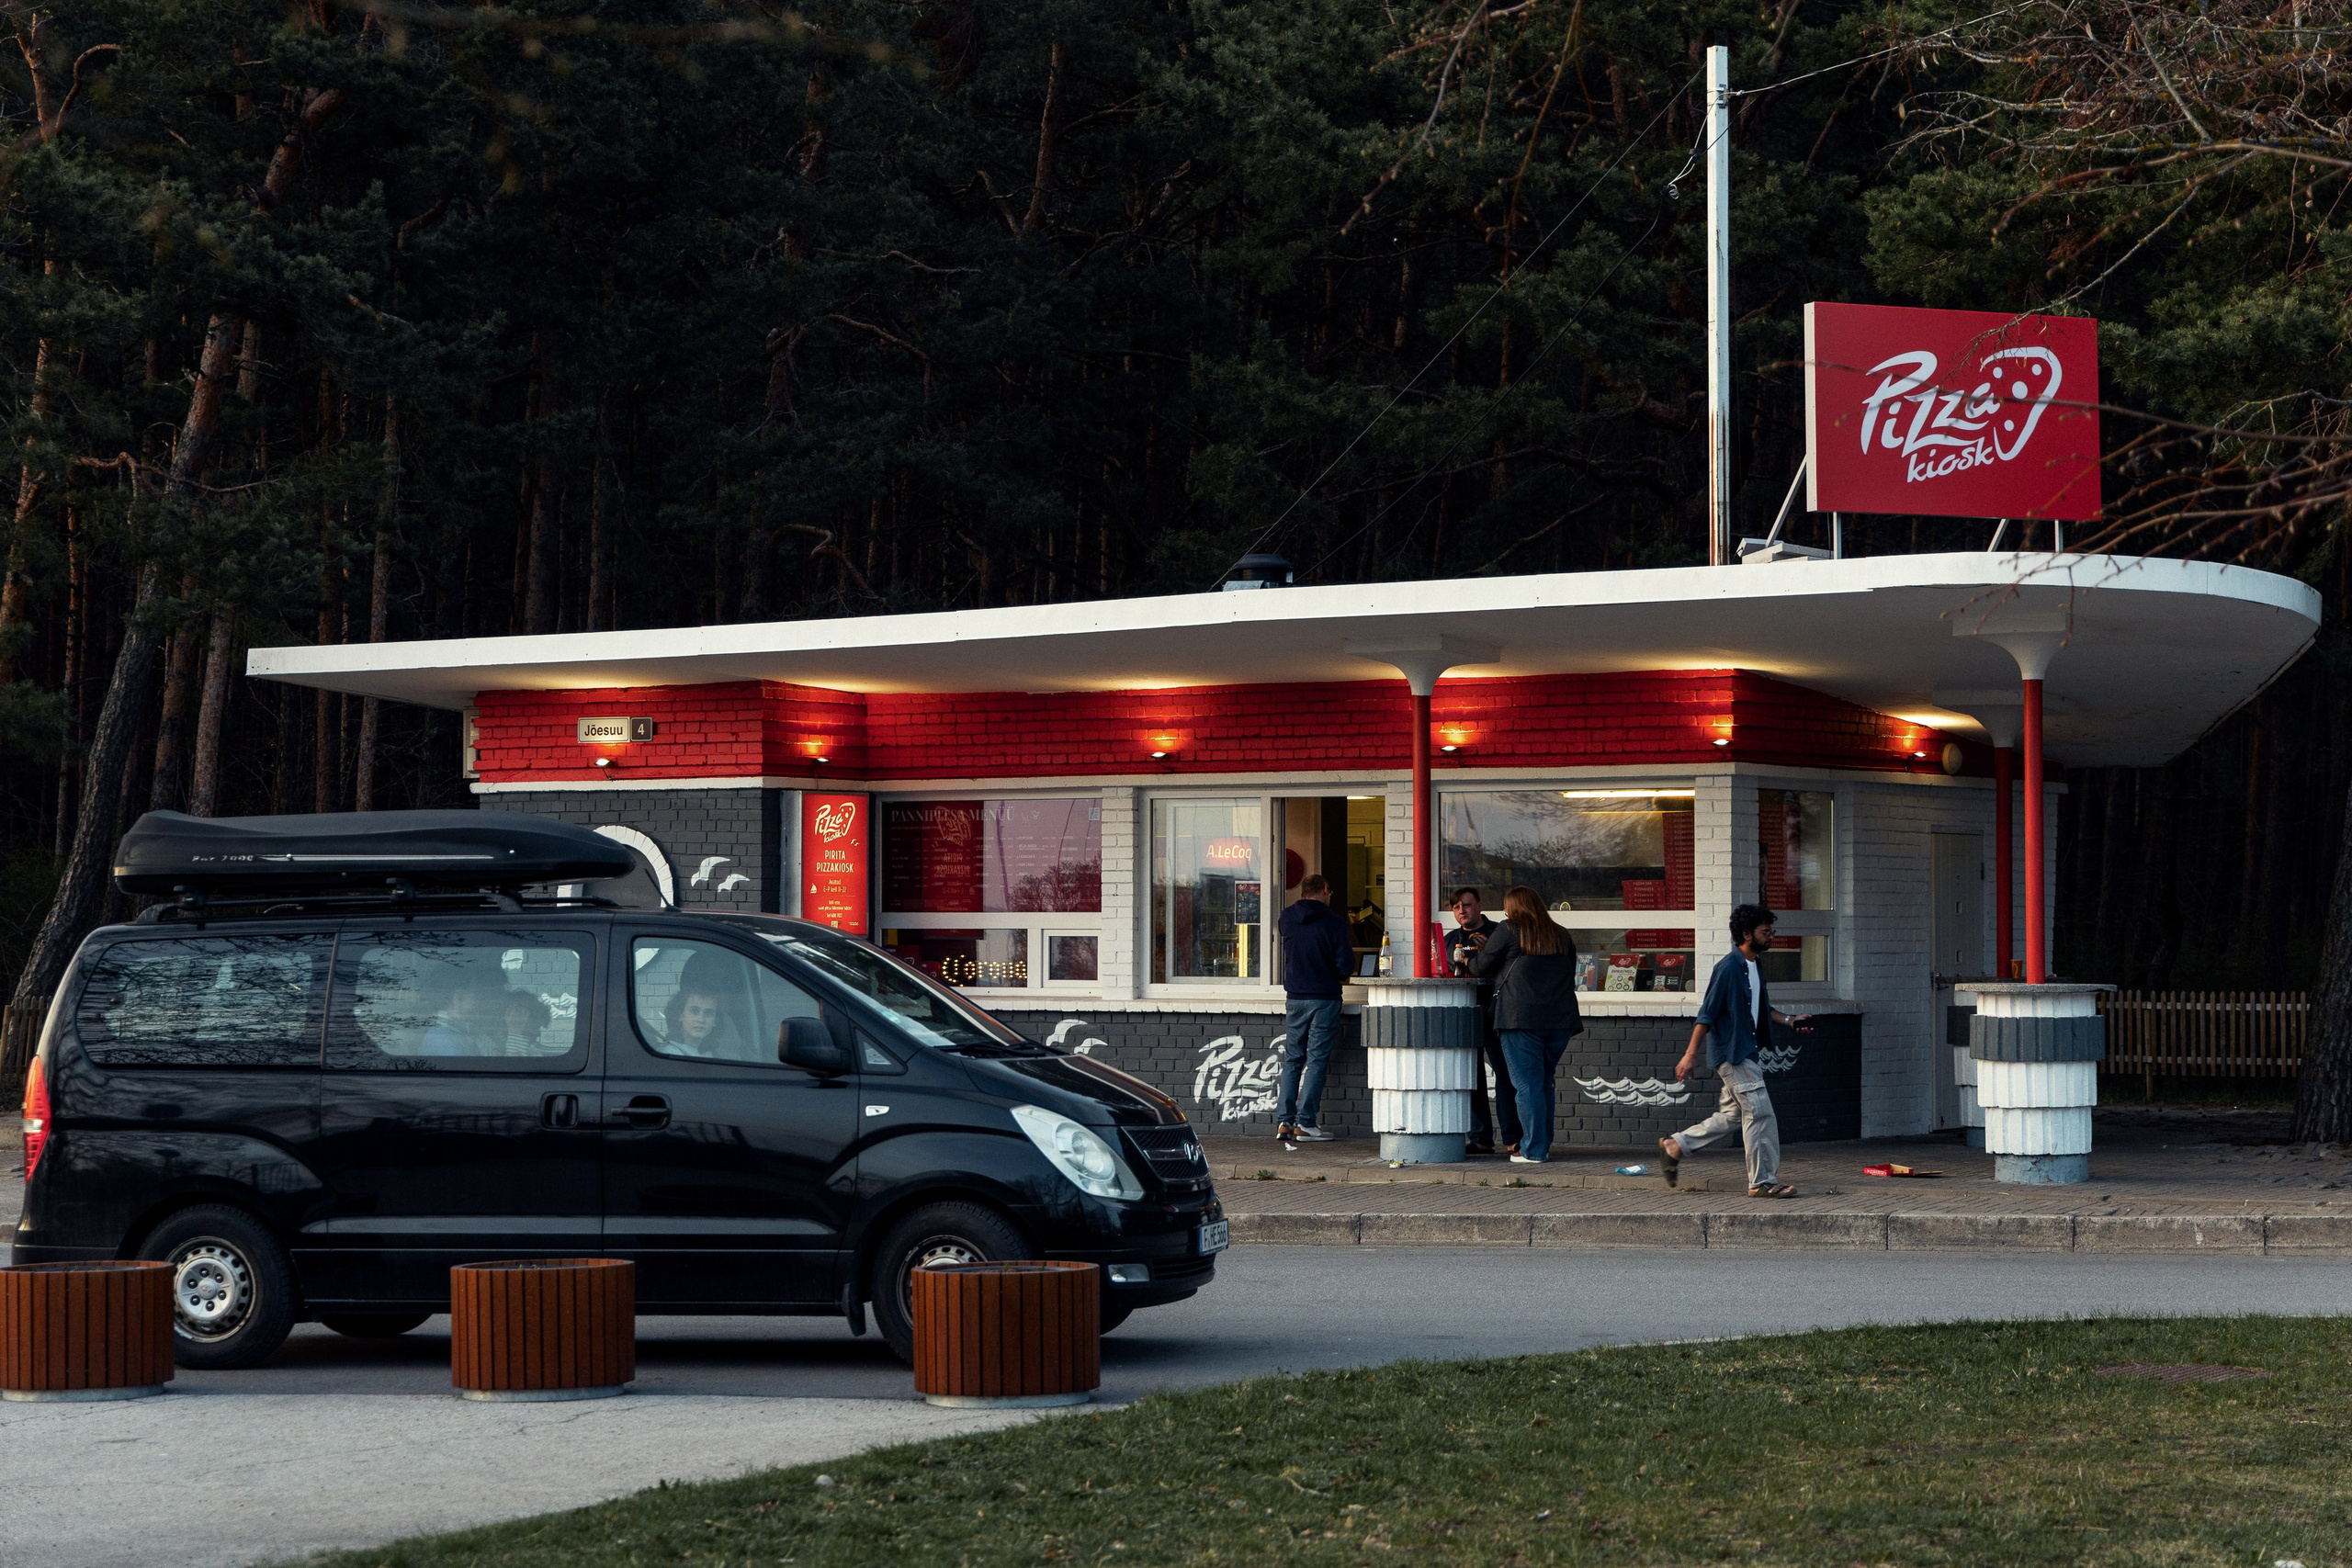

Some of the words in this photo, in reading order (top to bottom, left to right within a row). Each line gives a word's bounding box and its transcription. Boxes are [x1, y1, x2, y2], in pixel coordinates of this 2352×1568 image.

[1860, 350, 2001, 457] Pizza
[1906, 436, 1995, 483] kiosk
[584, 724, 623, 736] Jõesuu
[638, 723, 645, 736] 4
[814, 804, 843, 835] Pizza
[968, 807, 1014, 821] MENÜÜ
[823, 829, 842, 843] kiosk
[824, 850, 846, 860] PIRITA
[816, 862, 854, 873] PIZZAKIOSK
[1194, 1035, 1283, 1105] Pizza
